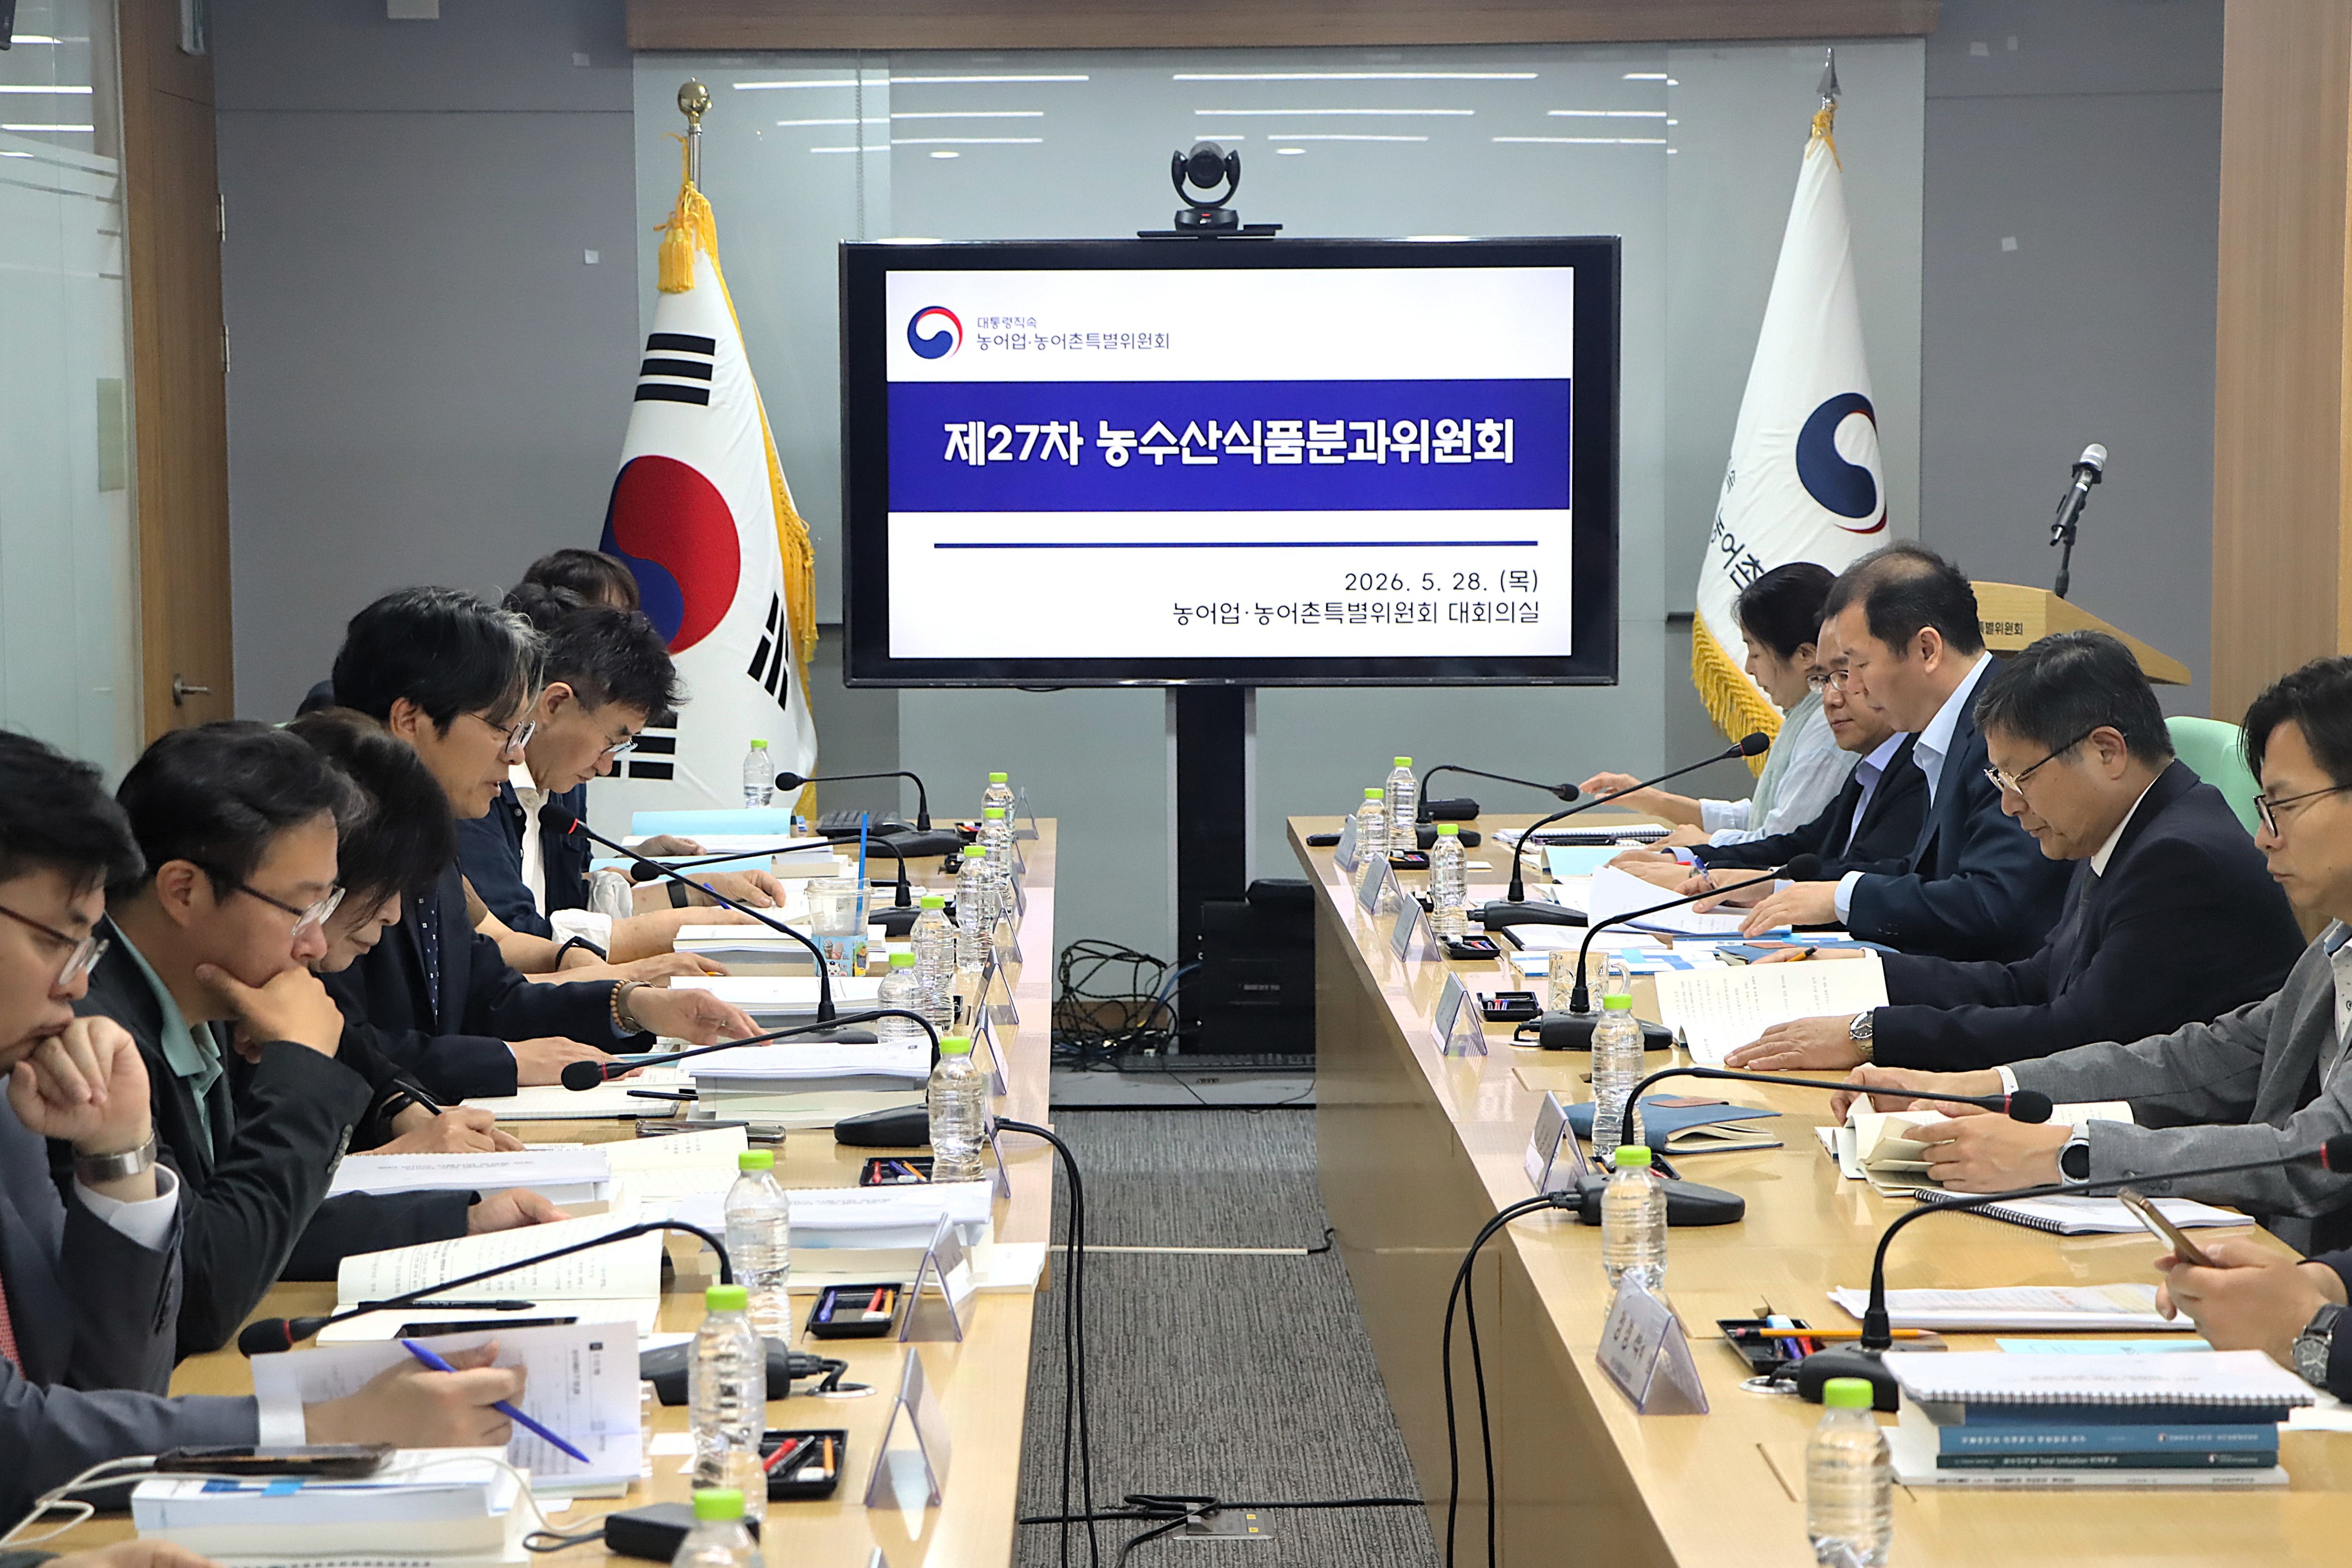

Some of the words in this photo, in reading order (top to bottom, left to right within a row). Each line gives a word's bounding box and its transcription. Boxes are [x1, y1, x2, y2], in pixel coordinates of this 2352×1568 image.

[978, 317, 1037, 330] 대통령직속
[977, 333, 1170, 351] 농어업·농어촌특별위원회
[944, 420, 1084, 467] 제27차
[1096, 418, 1514, 467] 농수산식품분과위원회
[1345, 572, 1410, 592] 2026.
[1421, 572, 1441, 592] 5.
[1453, 571, 1487, 592] 28.
[1500, 569, 1539, 594] (목)
[1172, 601, 1437, 626] 농어업·농어촌특별위원회
[1448, 601, 1539, 625] 대회의실
